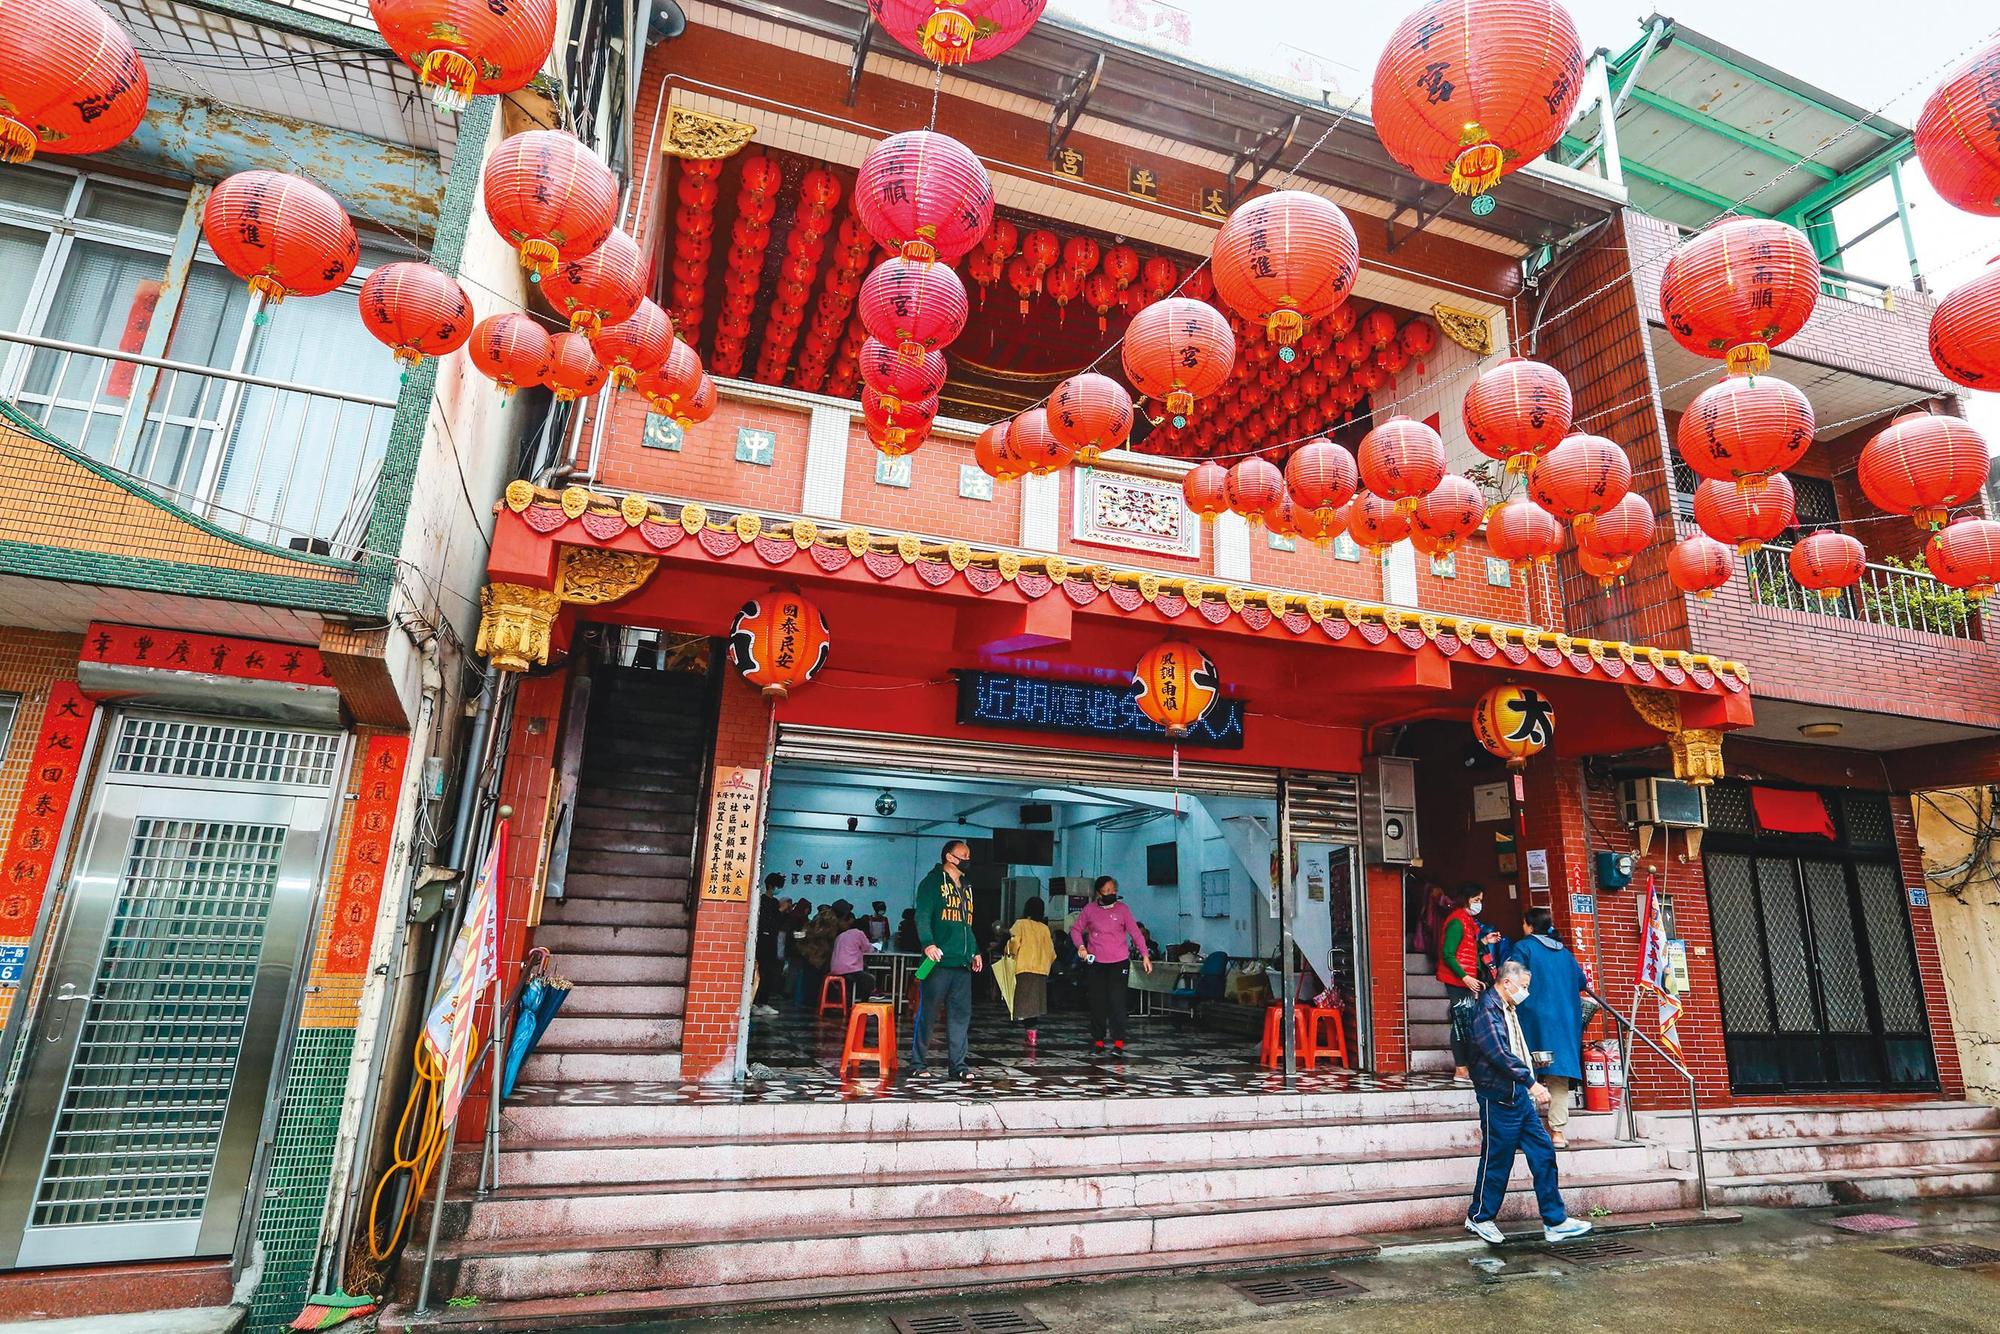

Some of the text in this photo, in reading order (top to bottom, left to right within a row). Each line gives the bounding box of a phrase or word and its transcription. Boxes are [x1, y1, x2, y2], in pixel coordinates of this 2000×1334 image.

[775, 603, 800, 670] 國泰民安
[1160, 651, 1179, 712] 風調雨順
[1504, 688, 1555, 748] 太
[732, 802, 752, 897] 中山里辦公處
